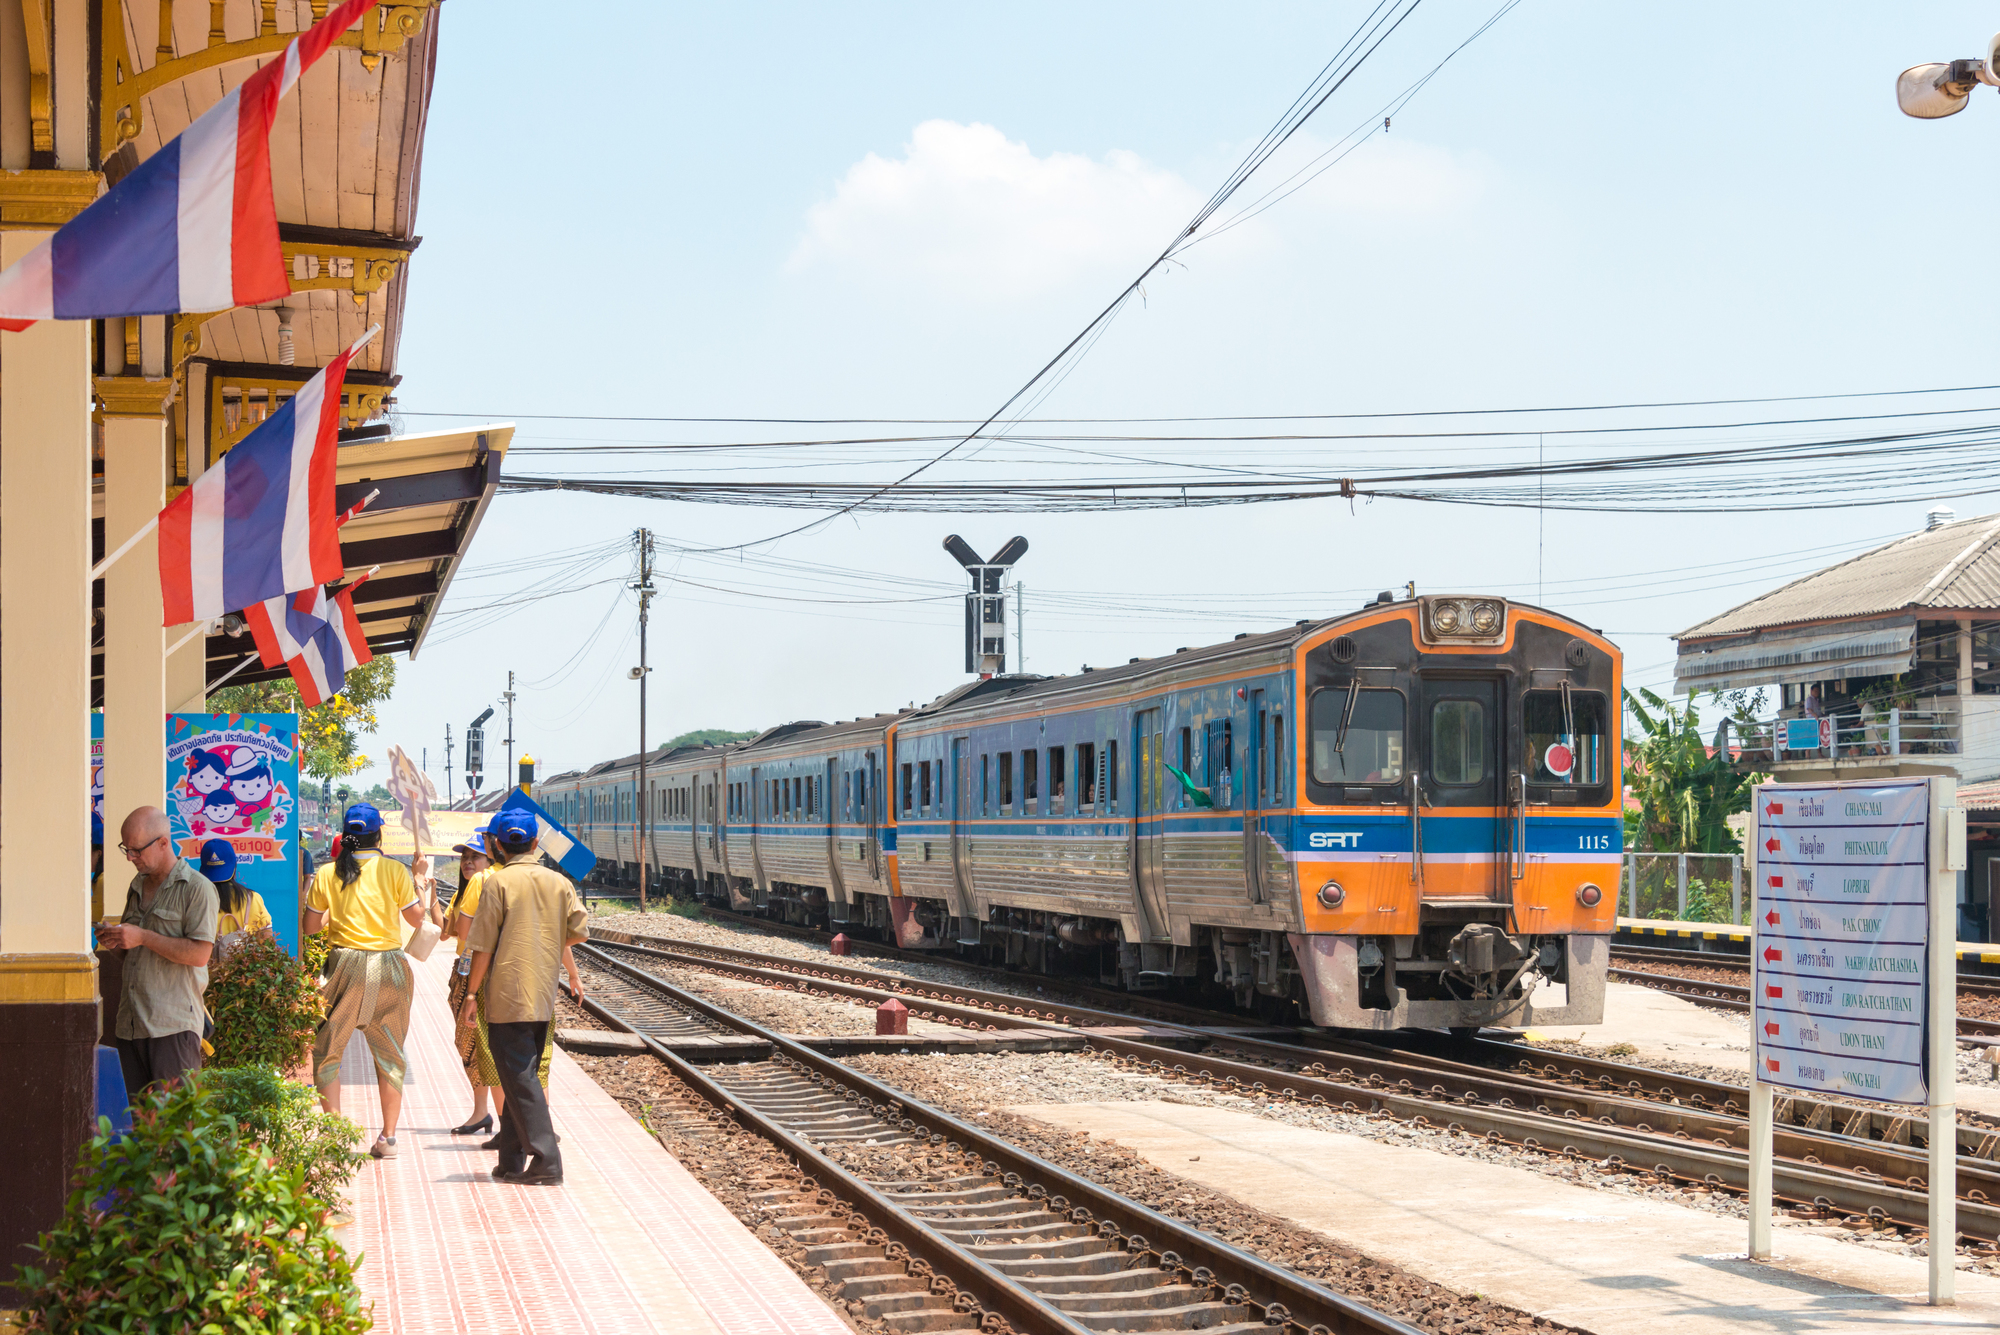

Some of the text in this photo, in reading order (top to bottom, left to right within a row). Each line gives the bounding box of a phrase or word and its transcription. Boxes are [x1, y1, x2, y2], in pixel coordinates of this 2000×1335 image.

[167, 733, 290, 760] เดินทางปลอดภัย ประกันภัยห่วงใยคุณ
[1798, 797, 1825, 817] เชียงใหม่
[1845, 802, 1882, 816] CHIANG MAI
[1309, 831, 1363, 848] SRT
[1578, 835, 1609, 850] 1115
[1799, 835, 1825, 860] พิษณุโลก
[1844, 841, 1889, 855] PHITSANULOK
[1797, 872, 1815, 897] ลพบุรี
[1843, 879, 1870, 893] LOPBURI
[1798, 910, 1821, 930] ปากช่อง
[1842, 918, 1882, 933] PAK CHONG
[1796, 948, 1834, 968] นครราชสีมา
[1868, 957, 1919, 973] RATCHASIMA
[1842, 992, 1912, 1012] UBON RATCHATHANI
[1840, 1032, 1885, 1050] UDON THANI
[1798, 1065, 1825, 1082] หนองคาย
[1842, 1071, 1881, 1089] NONG KHAI
